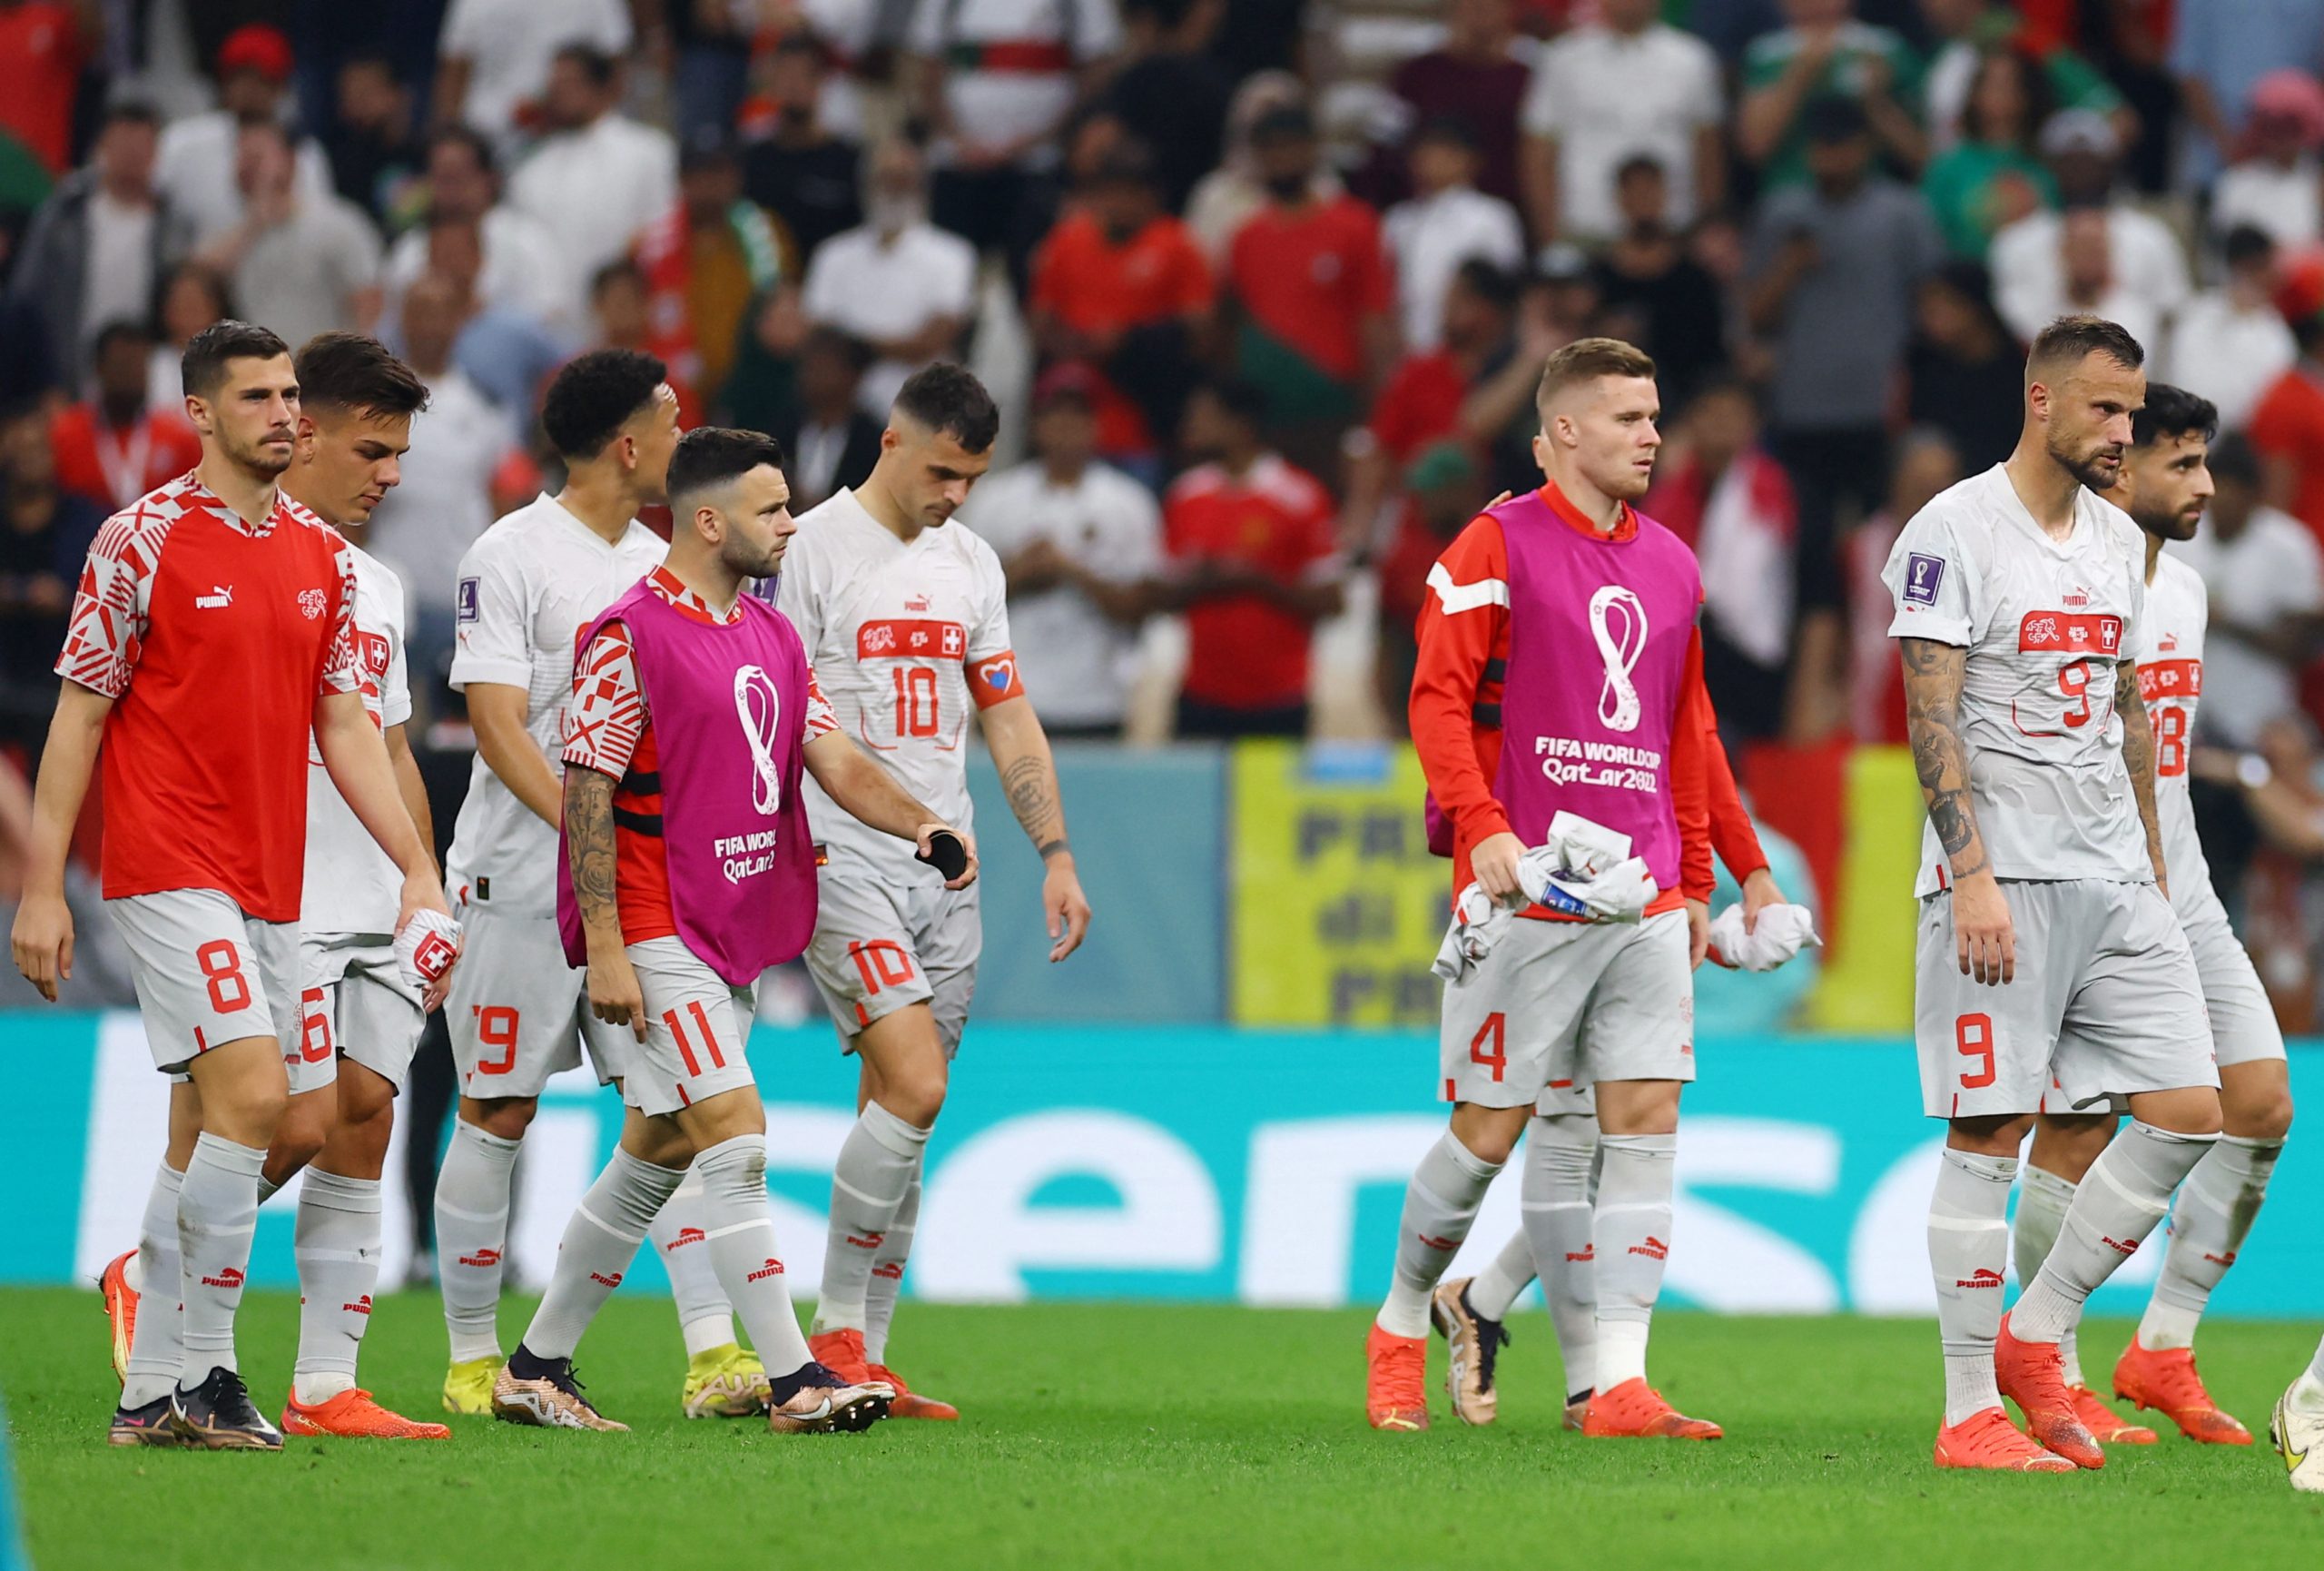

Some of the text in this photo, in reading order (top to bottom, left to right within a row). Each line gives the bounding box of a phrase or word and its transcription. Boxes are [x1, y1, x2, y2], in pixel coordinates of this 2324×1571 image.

[196, 596, 228, 608] PUMA
[2063, 596, 2088, 606] PUMA
[893, 667, 939, 738] 10
[2058, 660, 2091, 728] 9
[1535, 736, 1582, 758] FIFA
[1583, 741, 1644, 767] WORLD
[714, 835, 747, 858] FIFA
[196, 939, 251, 1014] 8
[848, 939, 914, 995] 10
[662, 1000, 726, 1078] 11
[1470, 1012, 1507, 1083] 4
[1955, 1012, 1996, 1089] 9
[458, 1257, 496, 1268] PUMA
[1626, 1246, 1664, 1260] PUMA
[201, 1276, 241, 1289] PUMA
[1955, 1279, 1998, 1289] PUMA
